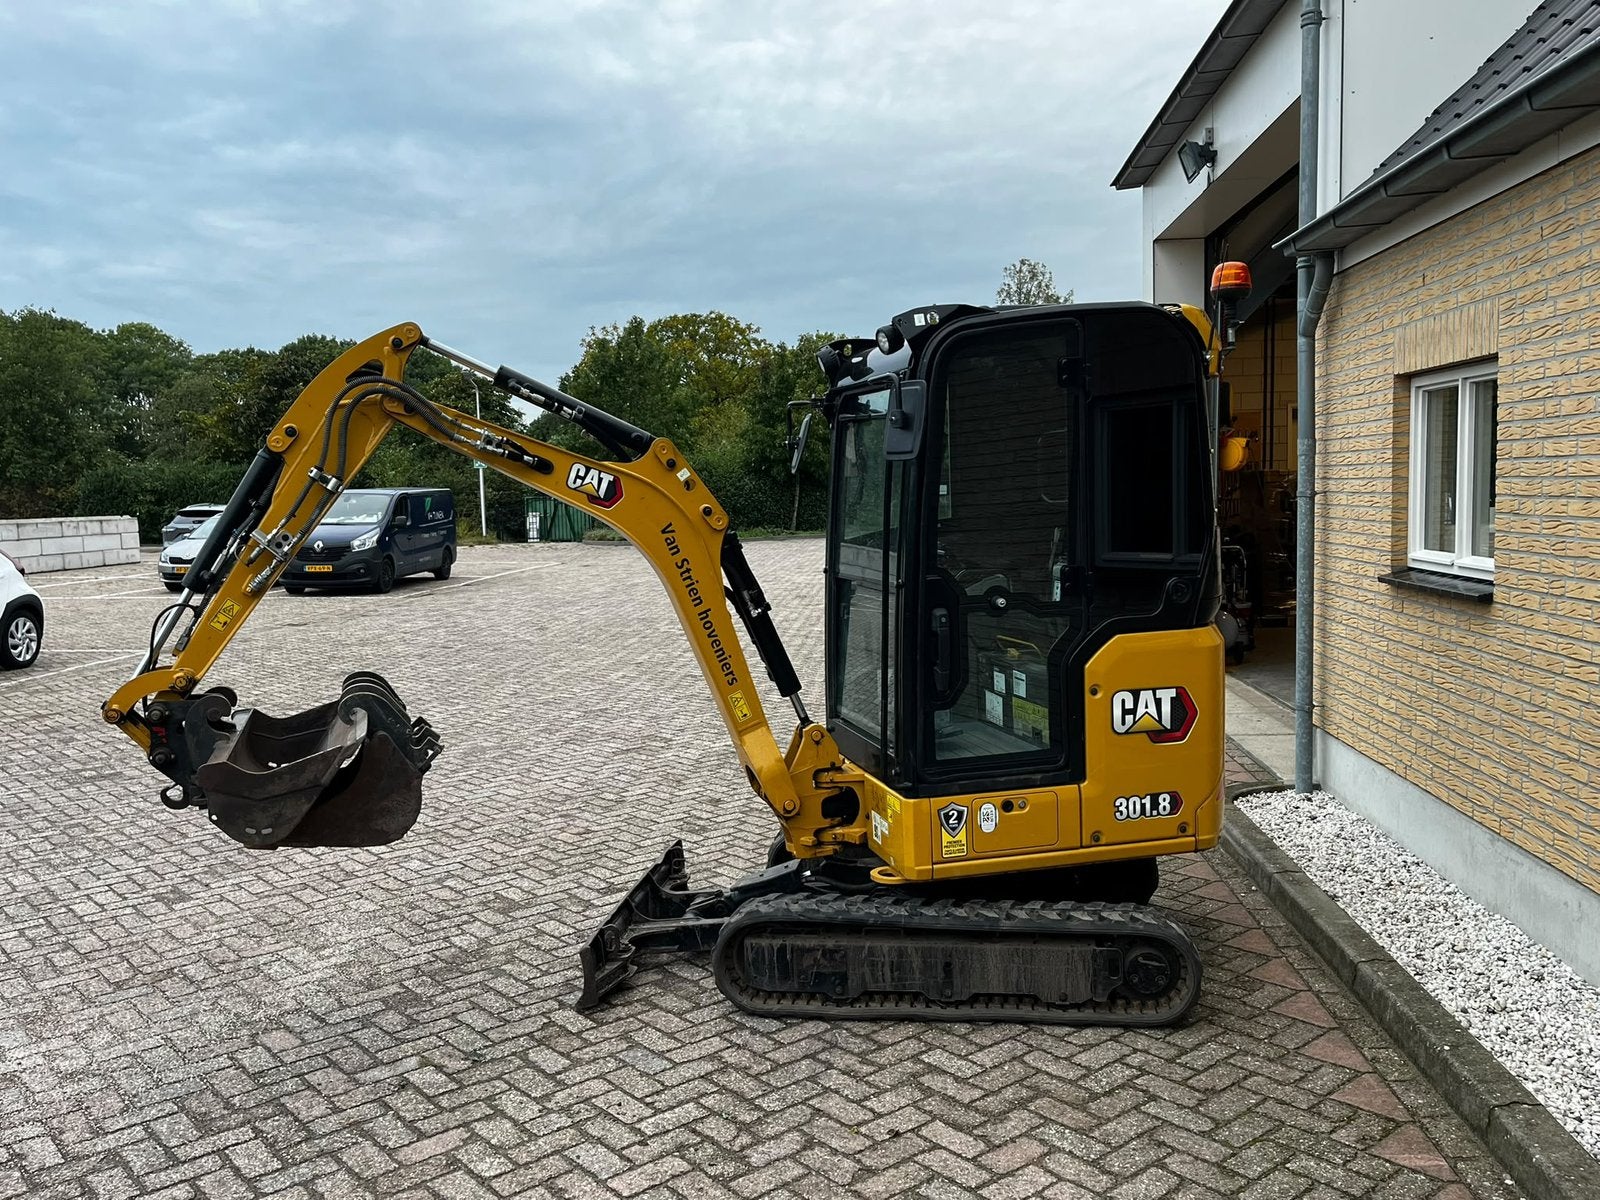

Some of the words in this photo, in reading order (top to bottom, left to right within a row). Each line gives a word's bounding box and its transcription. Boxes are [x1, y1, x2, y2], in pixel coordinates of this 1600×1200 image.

[567, 463, 614, 499] CAT
[660, 522, 682, 557] Van
[675, 557, 703, 608] Strien
[697, 607, 738, 687] hoveniers
[1112, 688, 1177, 734] CAT
[948, 810, 958, 823] 2
[1114, 793, 1171, 820] 301.8
